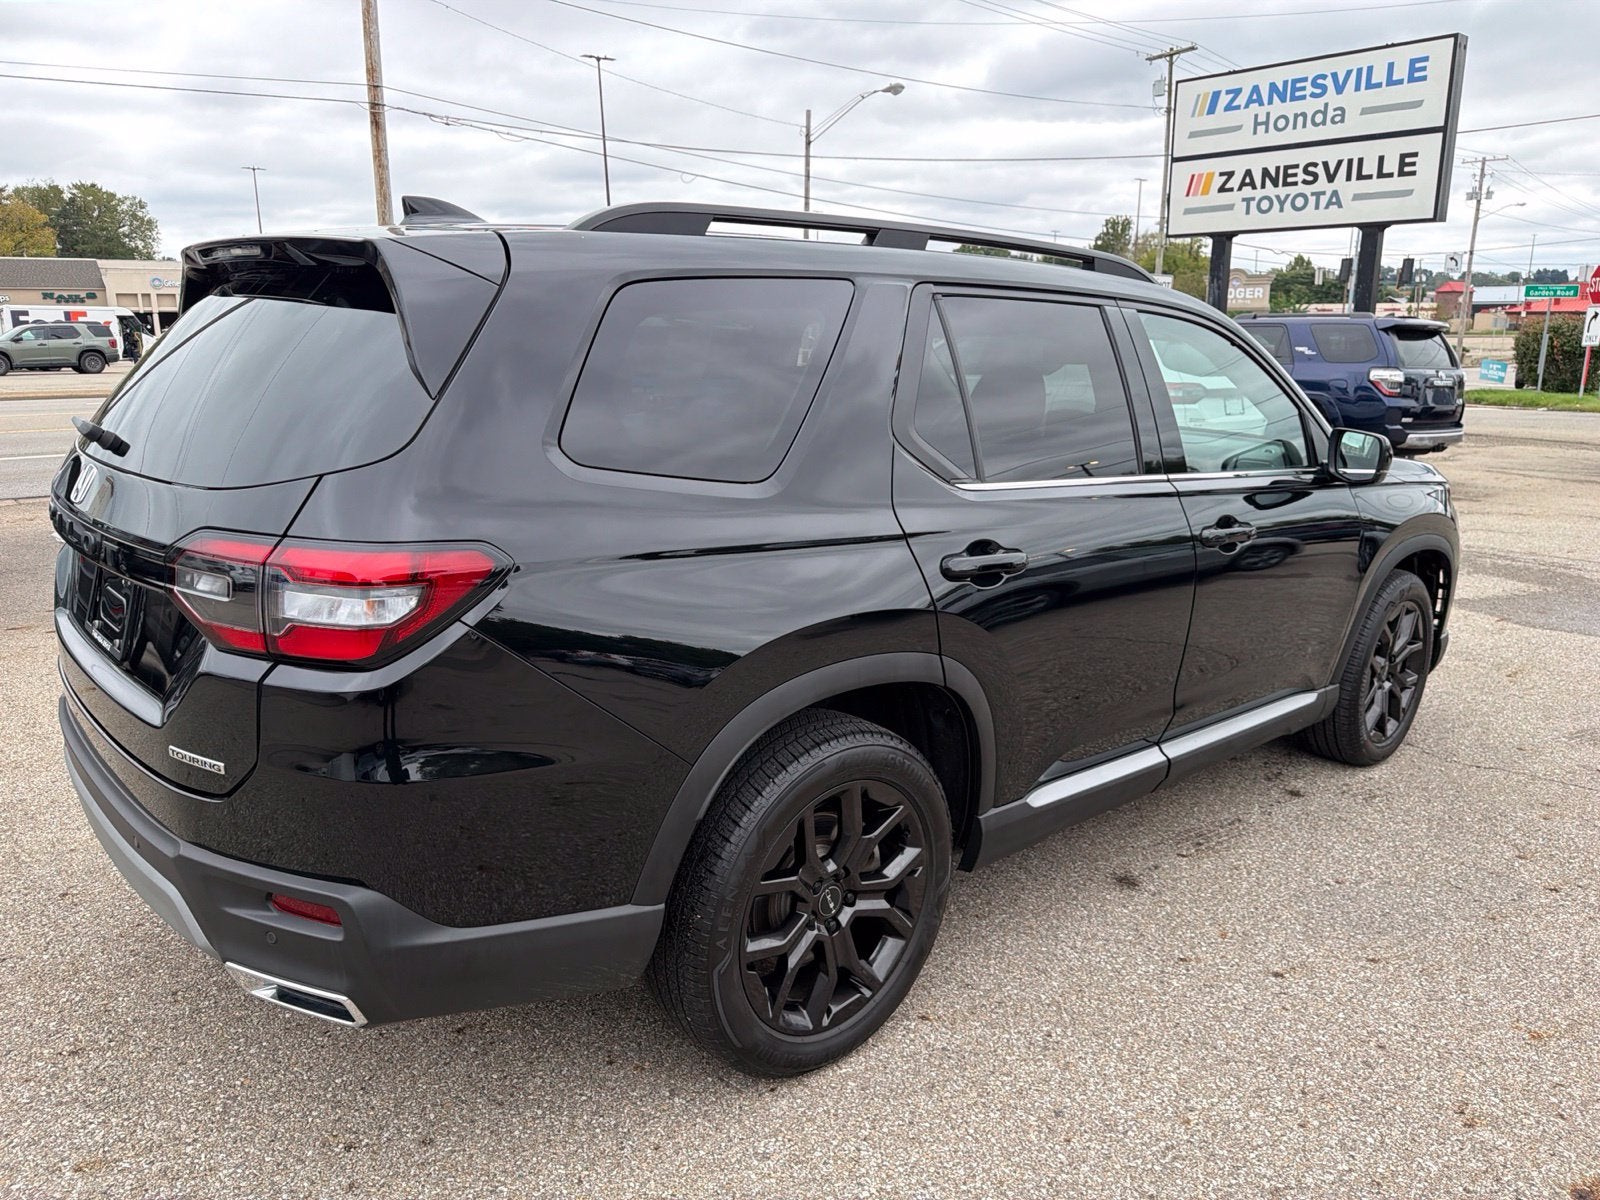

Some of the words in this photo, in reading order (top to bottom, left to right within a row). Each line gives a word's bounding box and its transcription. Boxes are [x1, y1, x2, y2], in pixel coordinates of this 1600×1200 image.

[1223, 55, 1430, 113] ZANESVILLE
[1252, 102, 1346, 136] Honda
[1217, 152, 1419, 194] ZANESVILLE
[1241, 190, 1344, 216] TOYOTA
[1227, 287, 1264, 299] OGER
[1584, 335, 1598, 343] ONLY
[169, 748, 222, 773] TOURING
